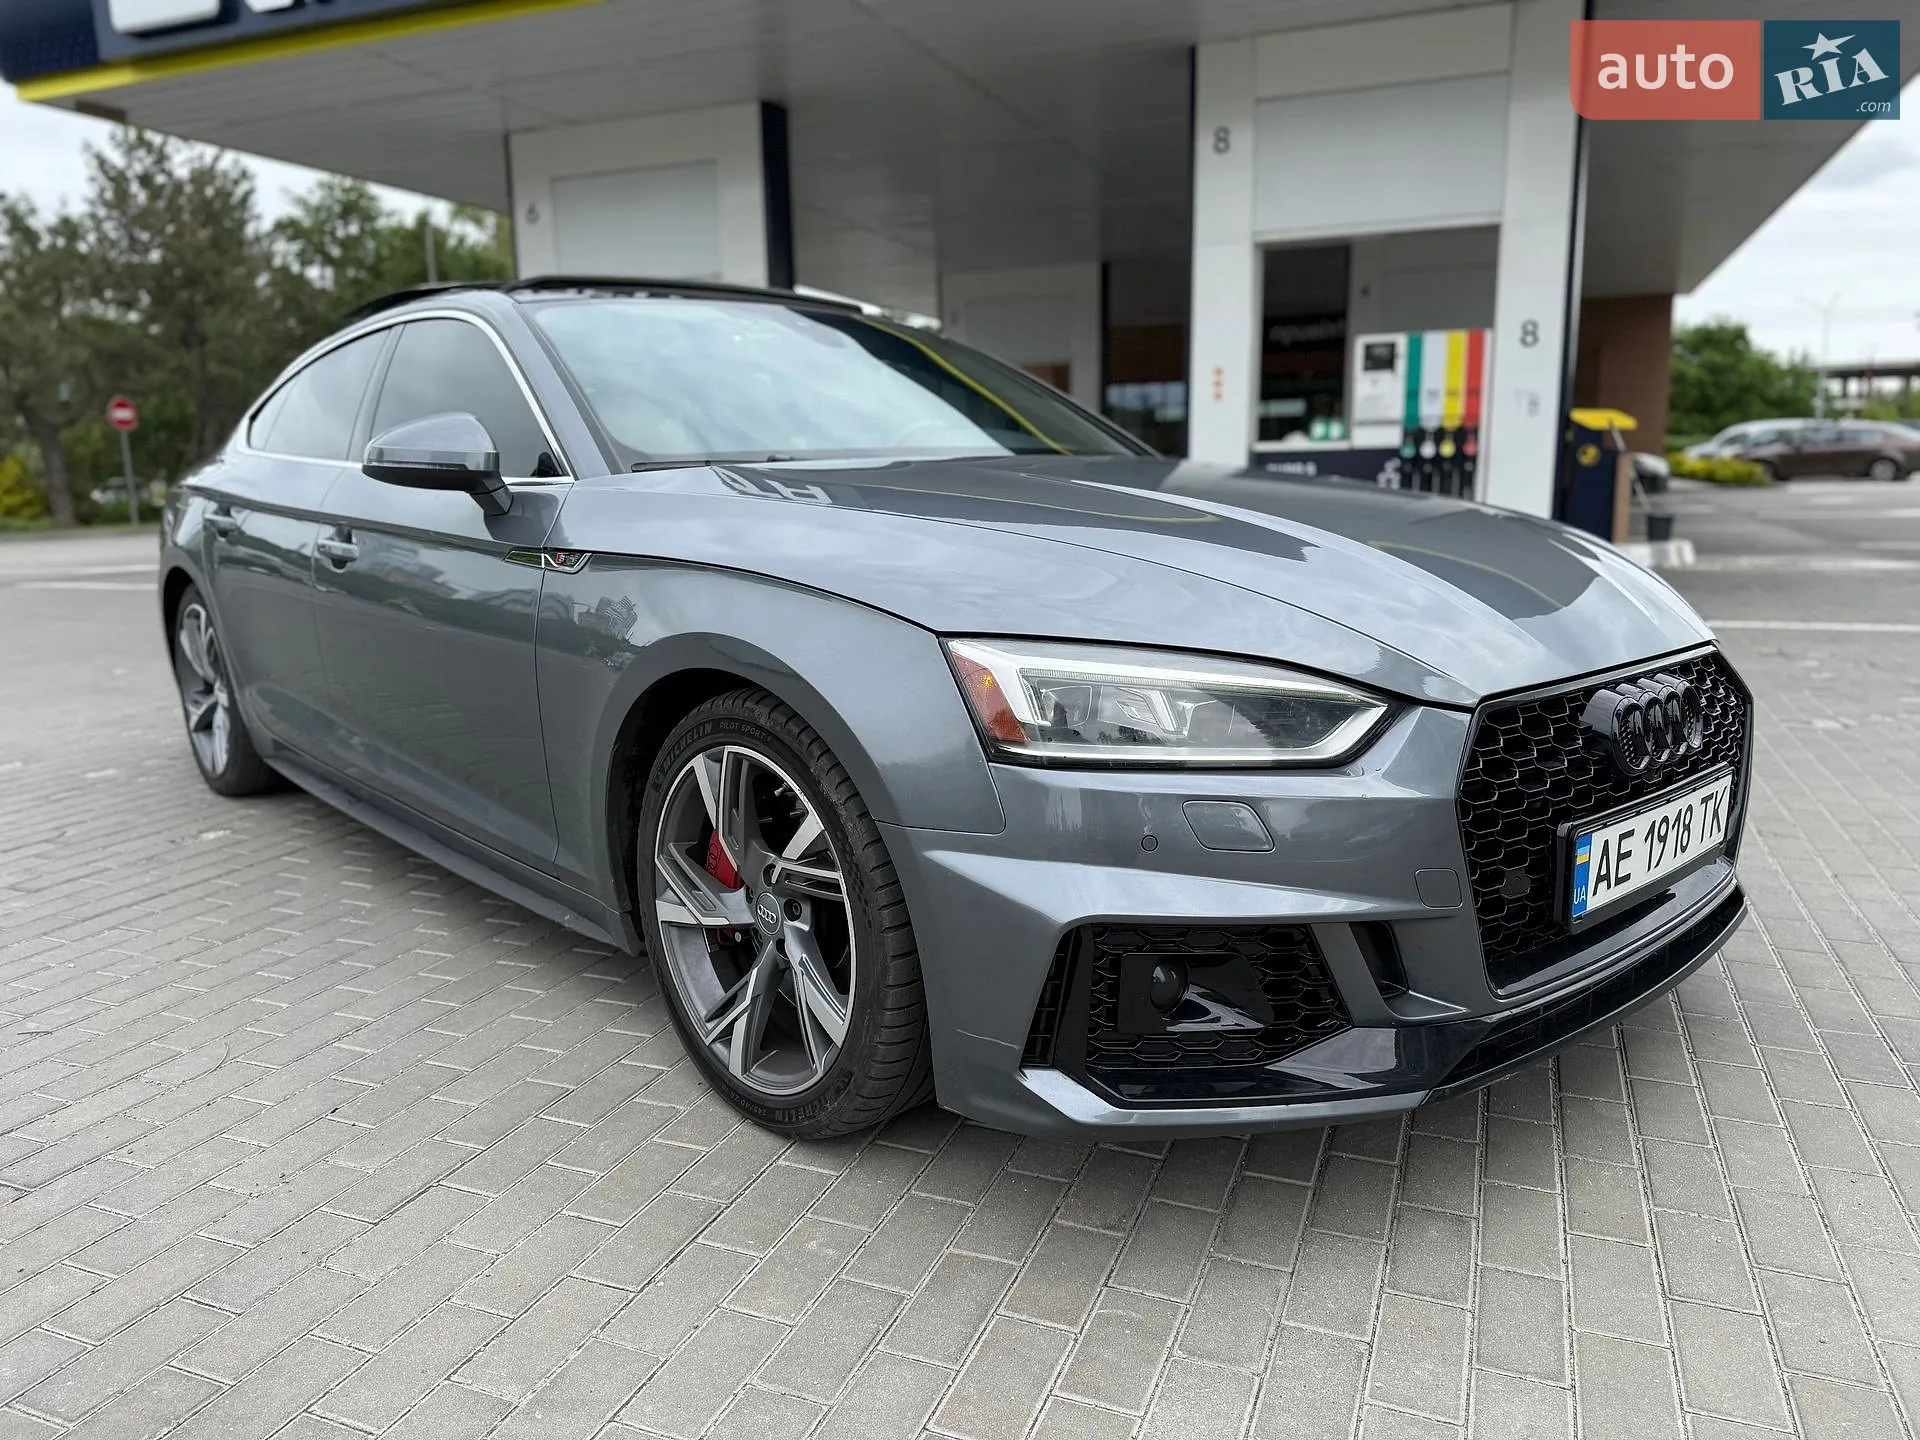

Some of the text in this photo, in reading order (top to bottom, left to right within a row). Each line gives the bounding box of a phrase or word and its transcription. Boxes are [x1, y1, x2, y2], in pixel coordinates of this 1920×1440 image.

[1212, 125, 1231, 156] 8
[525, 200, 541, 225] 6
[1520, 317, 1540, 348] 8
[663, 721, 713, 773] MICHELIN
[720, 721, 739, 730] PILOT
[741, 724, 766, 739] SPORT
[1574, 785, 1728, 904] UA AE 1918 TK
